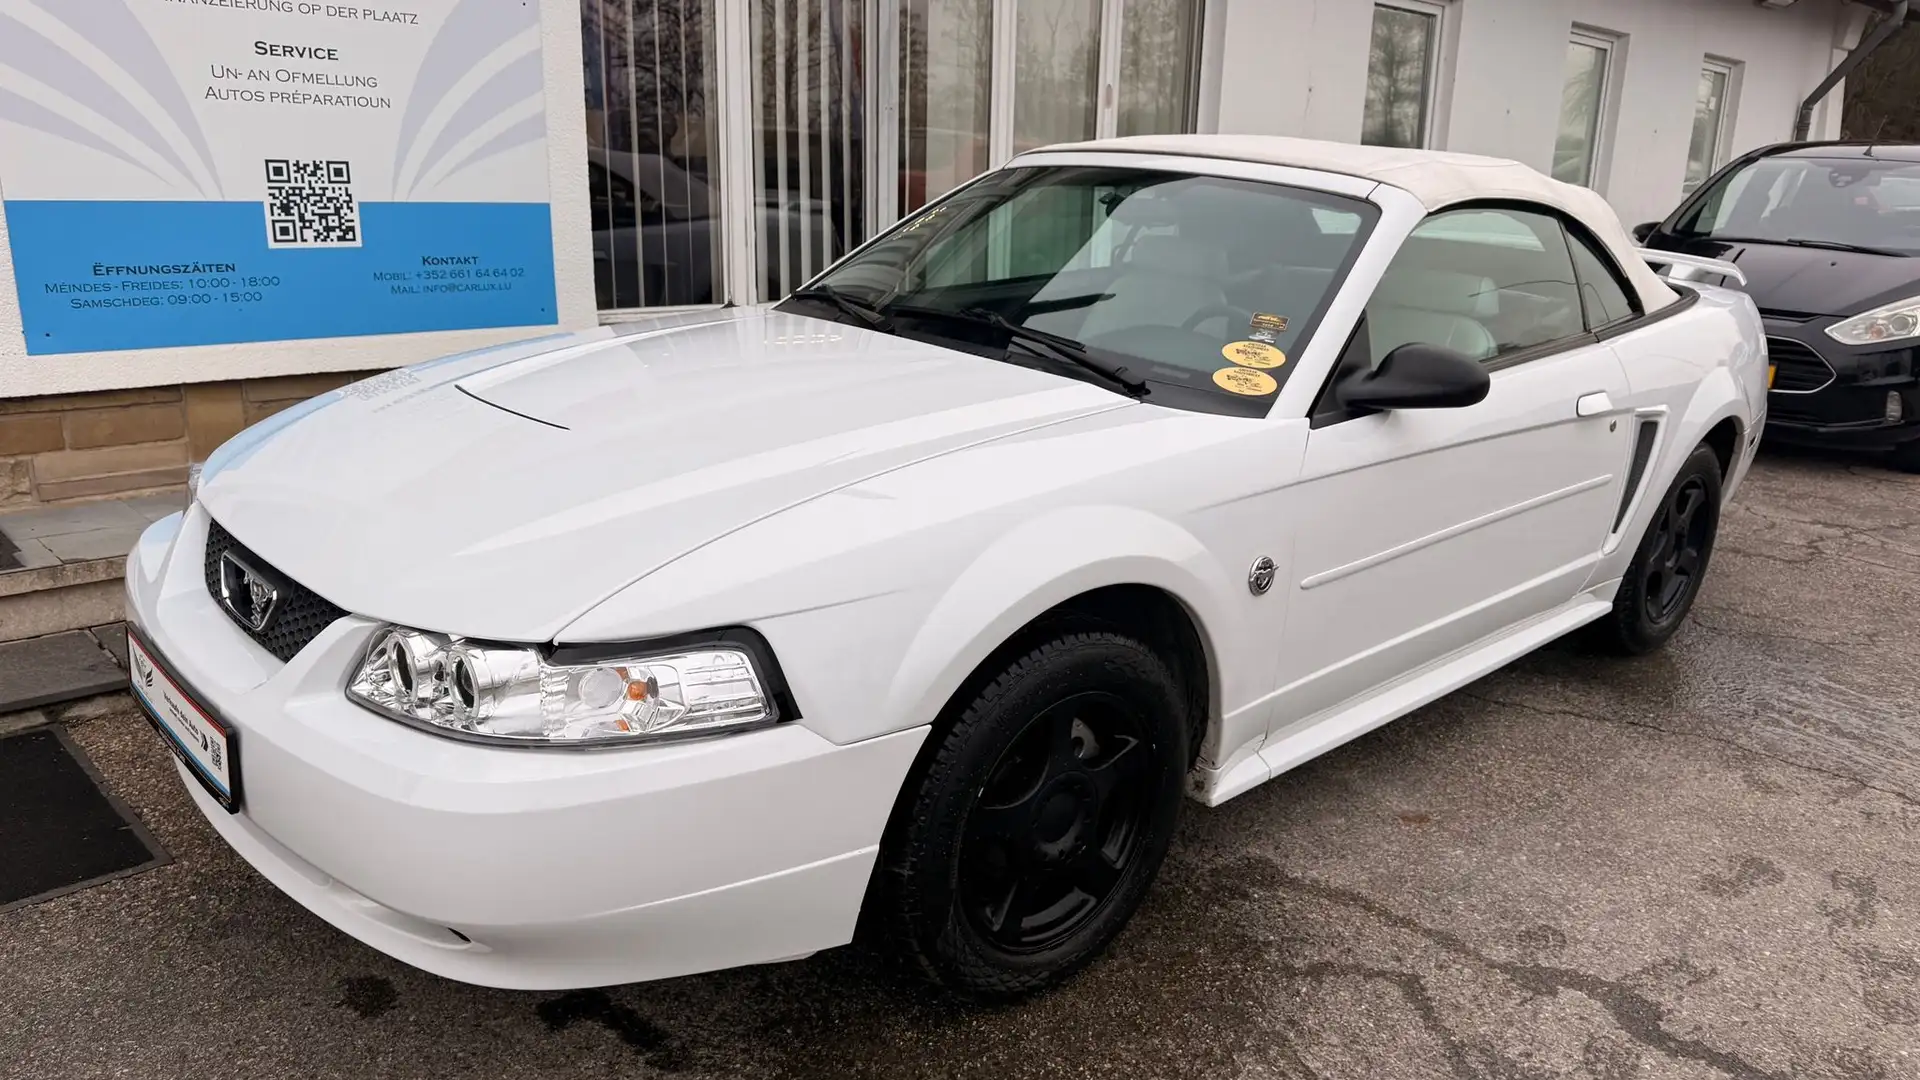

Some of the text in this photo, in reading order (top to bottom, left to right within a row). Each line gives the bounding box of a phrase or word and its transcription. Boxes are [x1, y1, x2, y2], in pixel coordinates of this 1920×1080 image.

[298, 3, 322, 15] OP
[326, 5, 359, 19] DER
[363, 9, 419, 24] PLAATZ
[254, 40, 339, 61] SERVICE
[275, 69, 378, 88] OFMELLUNG
[204, 86, 391, 108] AUTOS PRÉPARATIOUN
[421, 256, 479, 266] KONTAKT
[93, 262, 236, 276] ËFFNUNGSZÄITEN
[416, 270, 447, 280] +352
[189, 278, 230, 289] 10:00
[241, 276, 280, 288] 18:00
[167, 293, 212, 305] 09:00
[223, 291, 263, 303] 15:00
